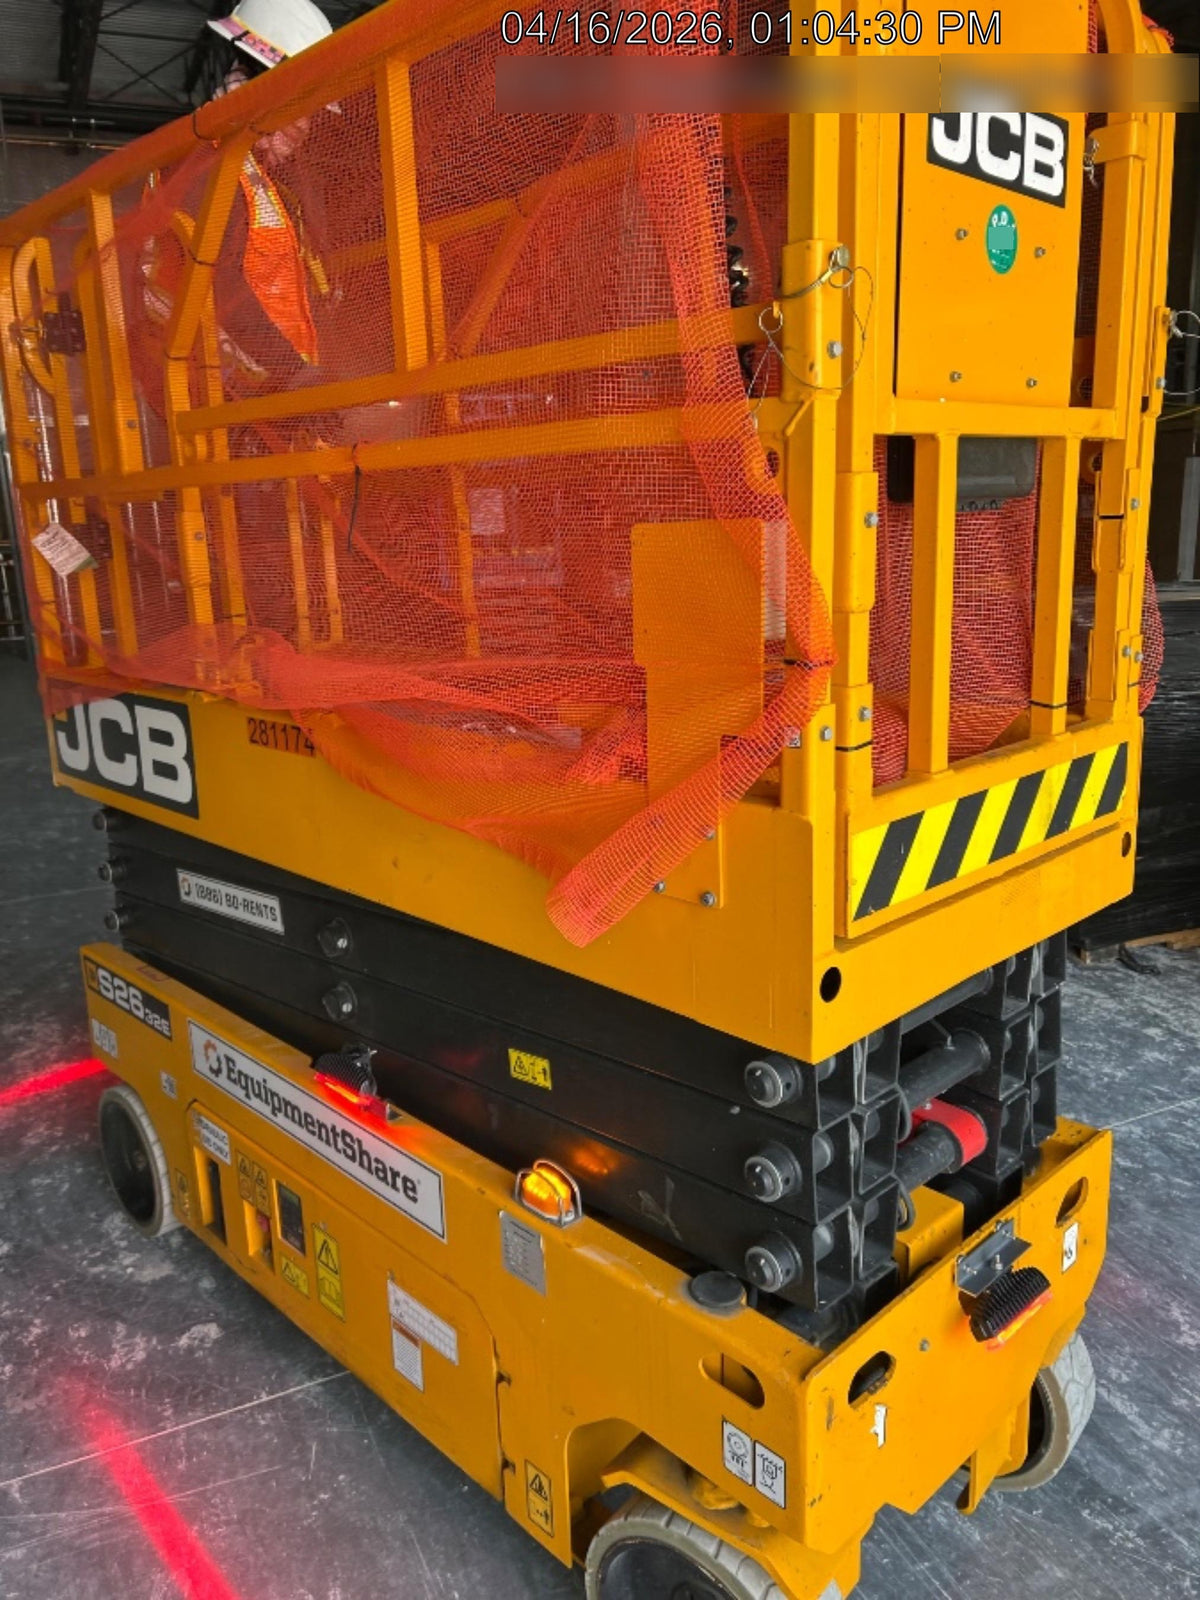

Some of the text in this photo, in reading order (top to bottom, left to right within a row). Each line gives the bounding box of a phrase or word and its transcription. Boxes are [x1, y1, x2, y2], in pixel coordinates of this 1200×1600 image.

[932, 112, 1066, 197] JCB
[56, 697, 193, 804] JCB
[247, 716, 316, 758] 281174
[223, 1054, 419, 1204] EquipmentShare
